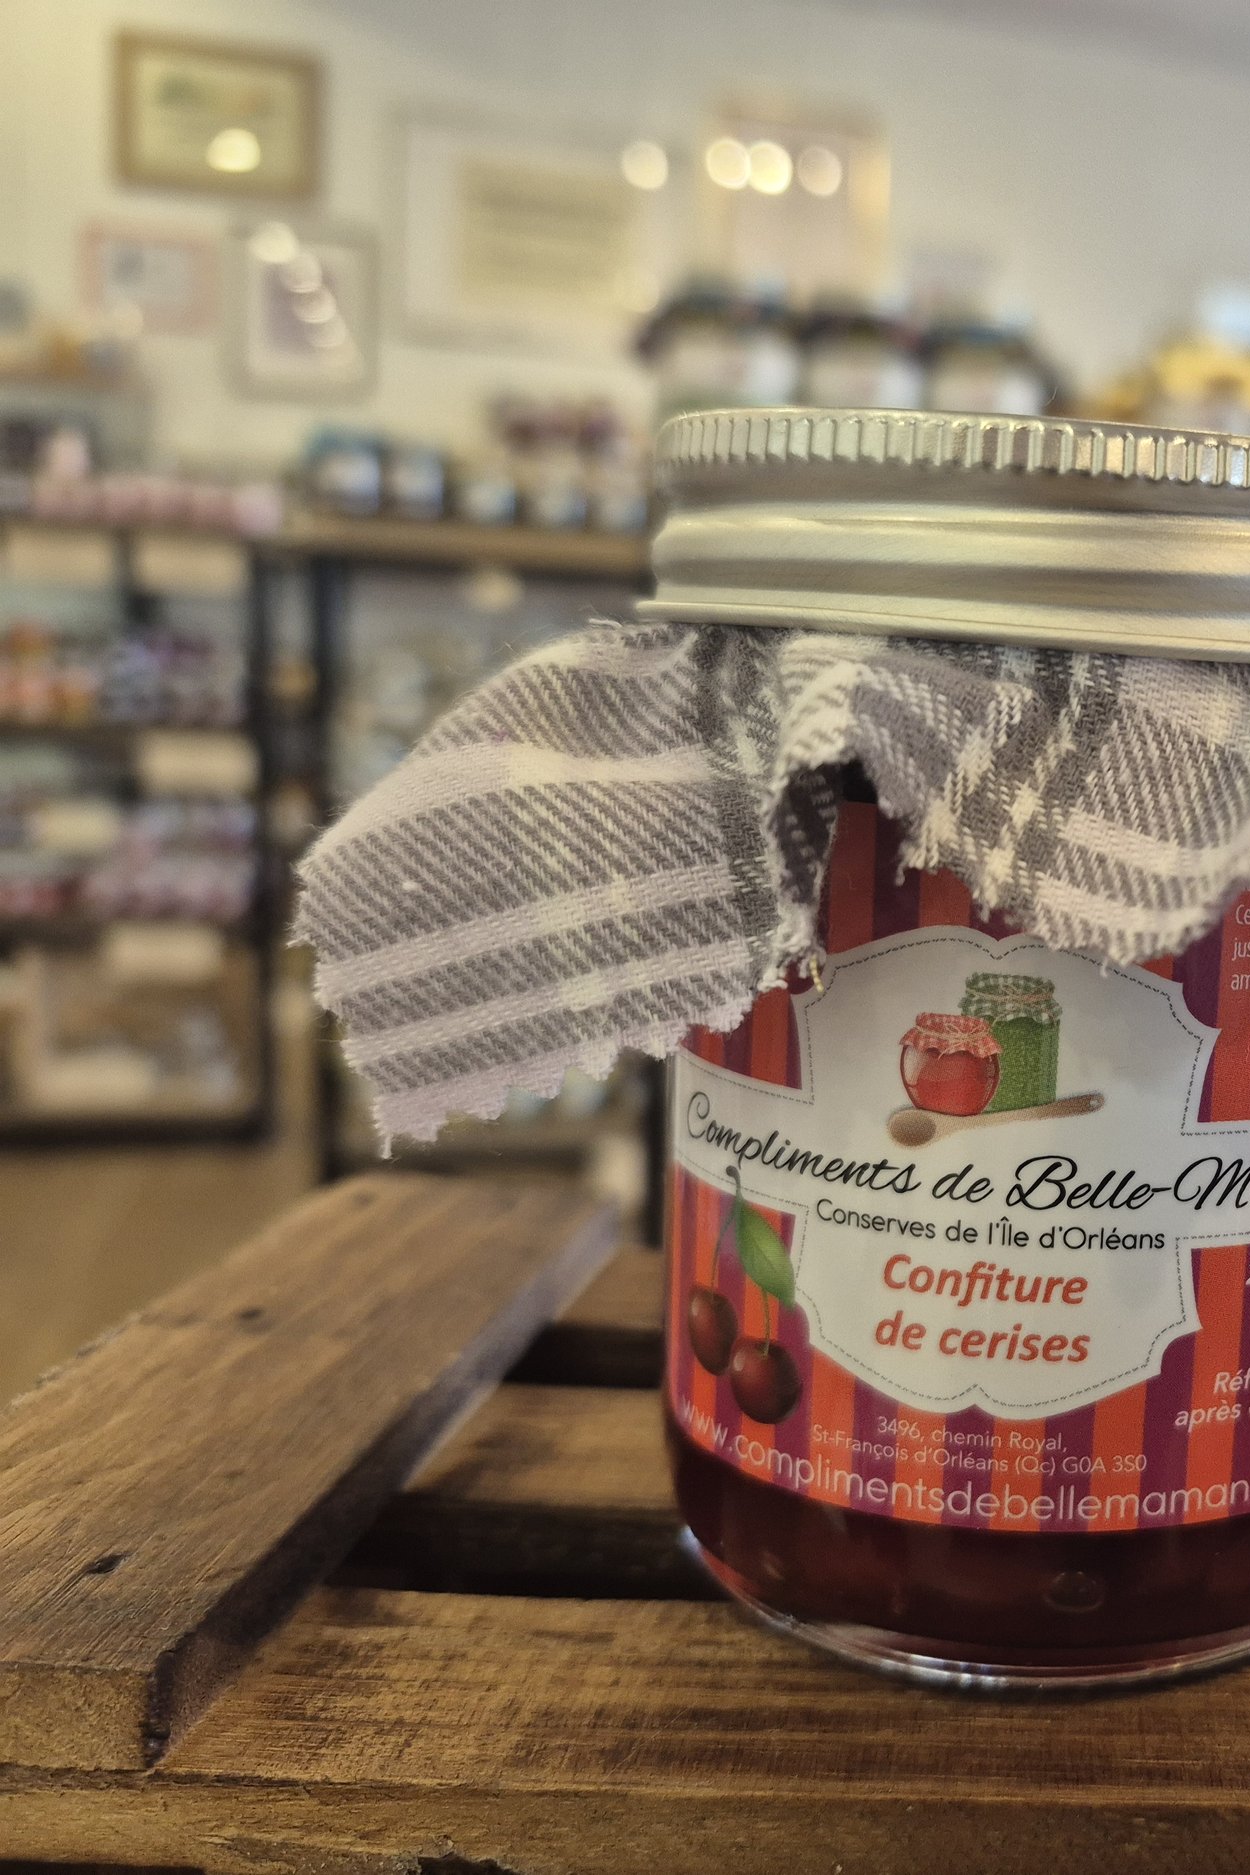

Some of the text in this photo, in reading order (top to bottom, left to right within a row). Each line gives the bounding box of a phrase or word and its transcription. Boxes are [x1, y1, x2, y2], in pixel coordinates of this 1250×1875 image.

[686, 1090, 922, 1194] Compliments
[931, 1163, 995, 1204] de
[816, 1198, 1165, 1250] Conserves de l'Île d'Orléans
[882, 1253, 1089, 1307] Confiture
[874, 1309, 1091, 1363] de cerises
[877, 1415, 1067, 1453] 3496, chemin Royal,
[1174, 1398, 1241, 1433] après
[812, 1424, 909, 1462] St-François
[914, 1446, 1009, 1473] d'Orléans
[1015, 1455, 1056, 1476] (Qc)
